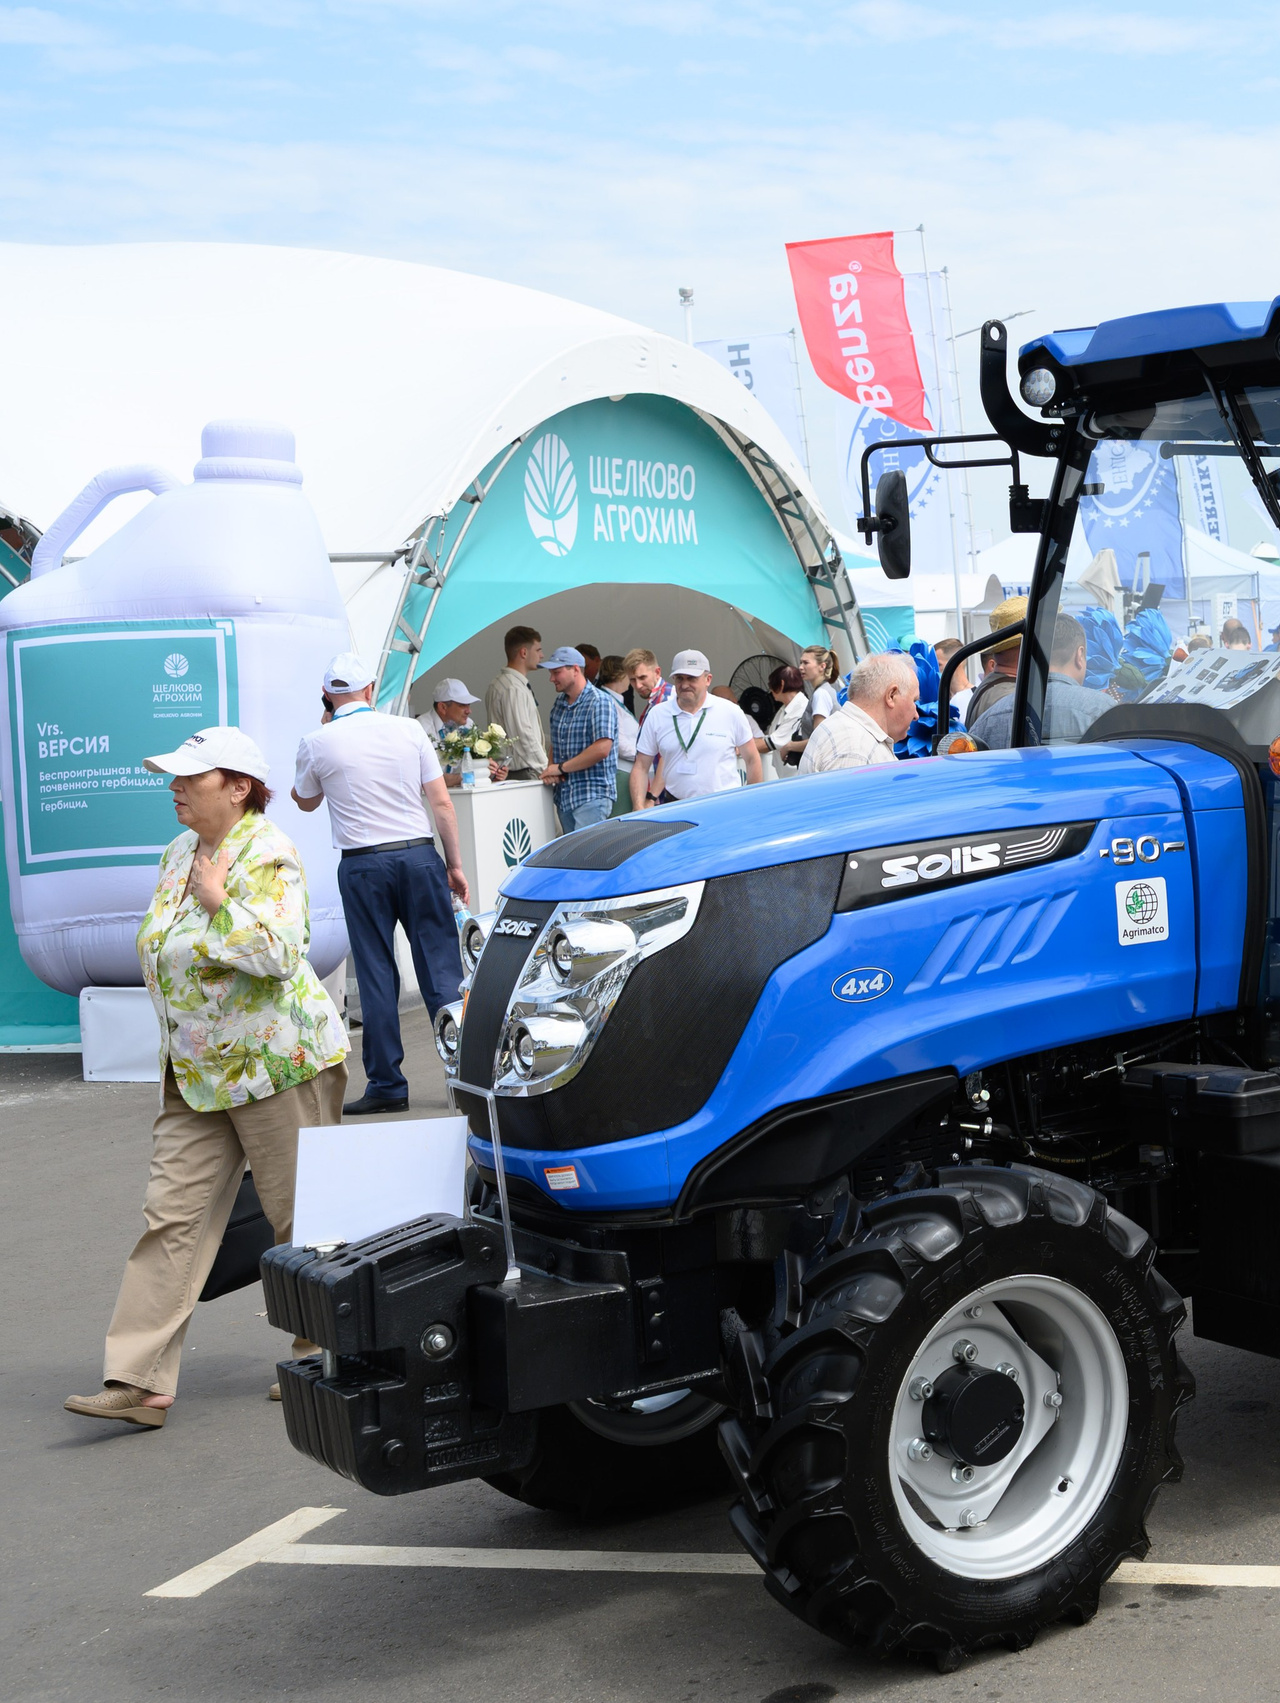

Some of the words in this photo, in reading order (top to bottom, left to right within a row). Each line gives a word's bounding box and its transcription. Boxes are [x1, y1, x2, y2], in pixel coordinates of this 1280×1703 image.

[589, 455, 696, 502] ЩЕЛКОВО
[594, 503, 699, 546] АГРОХИМ
[152, 683, 203, 694] ЩЕЛКОВО
[152, 693, 203, 703] АГРОХИМ
[36, 722, 64, 737] Vrs.
[38, 735, 110, 759] ВЕРСИЯ
[39, 766, 131, 782] Беспроигрышная
[39, 778, 99, 794] почвенного
[101, 776, 164, 790] гербицида
[40, 800, 88, 813] Гербицид
[1122, 925, 1166, 941] Agrimatco
[840, 973, 885, 996] 4x4
